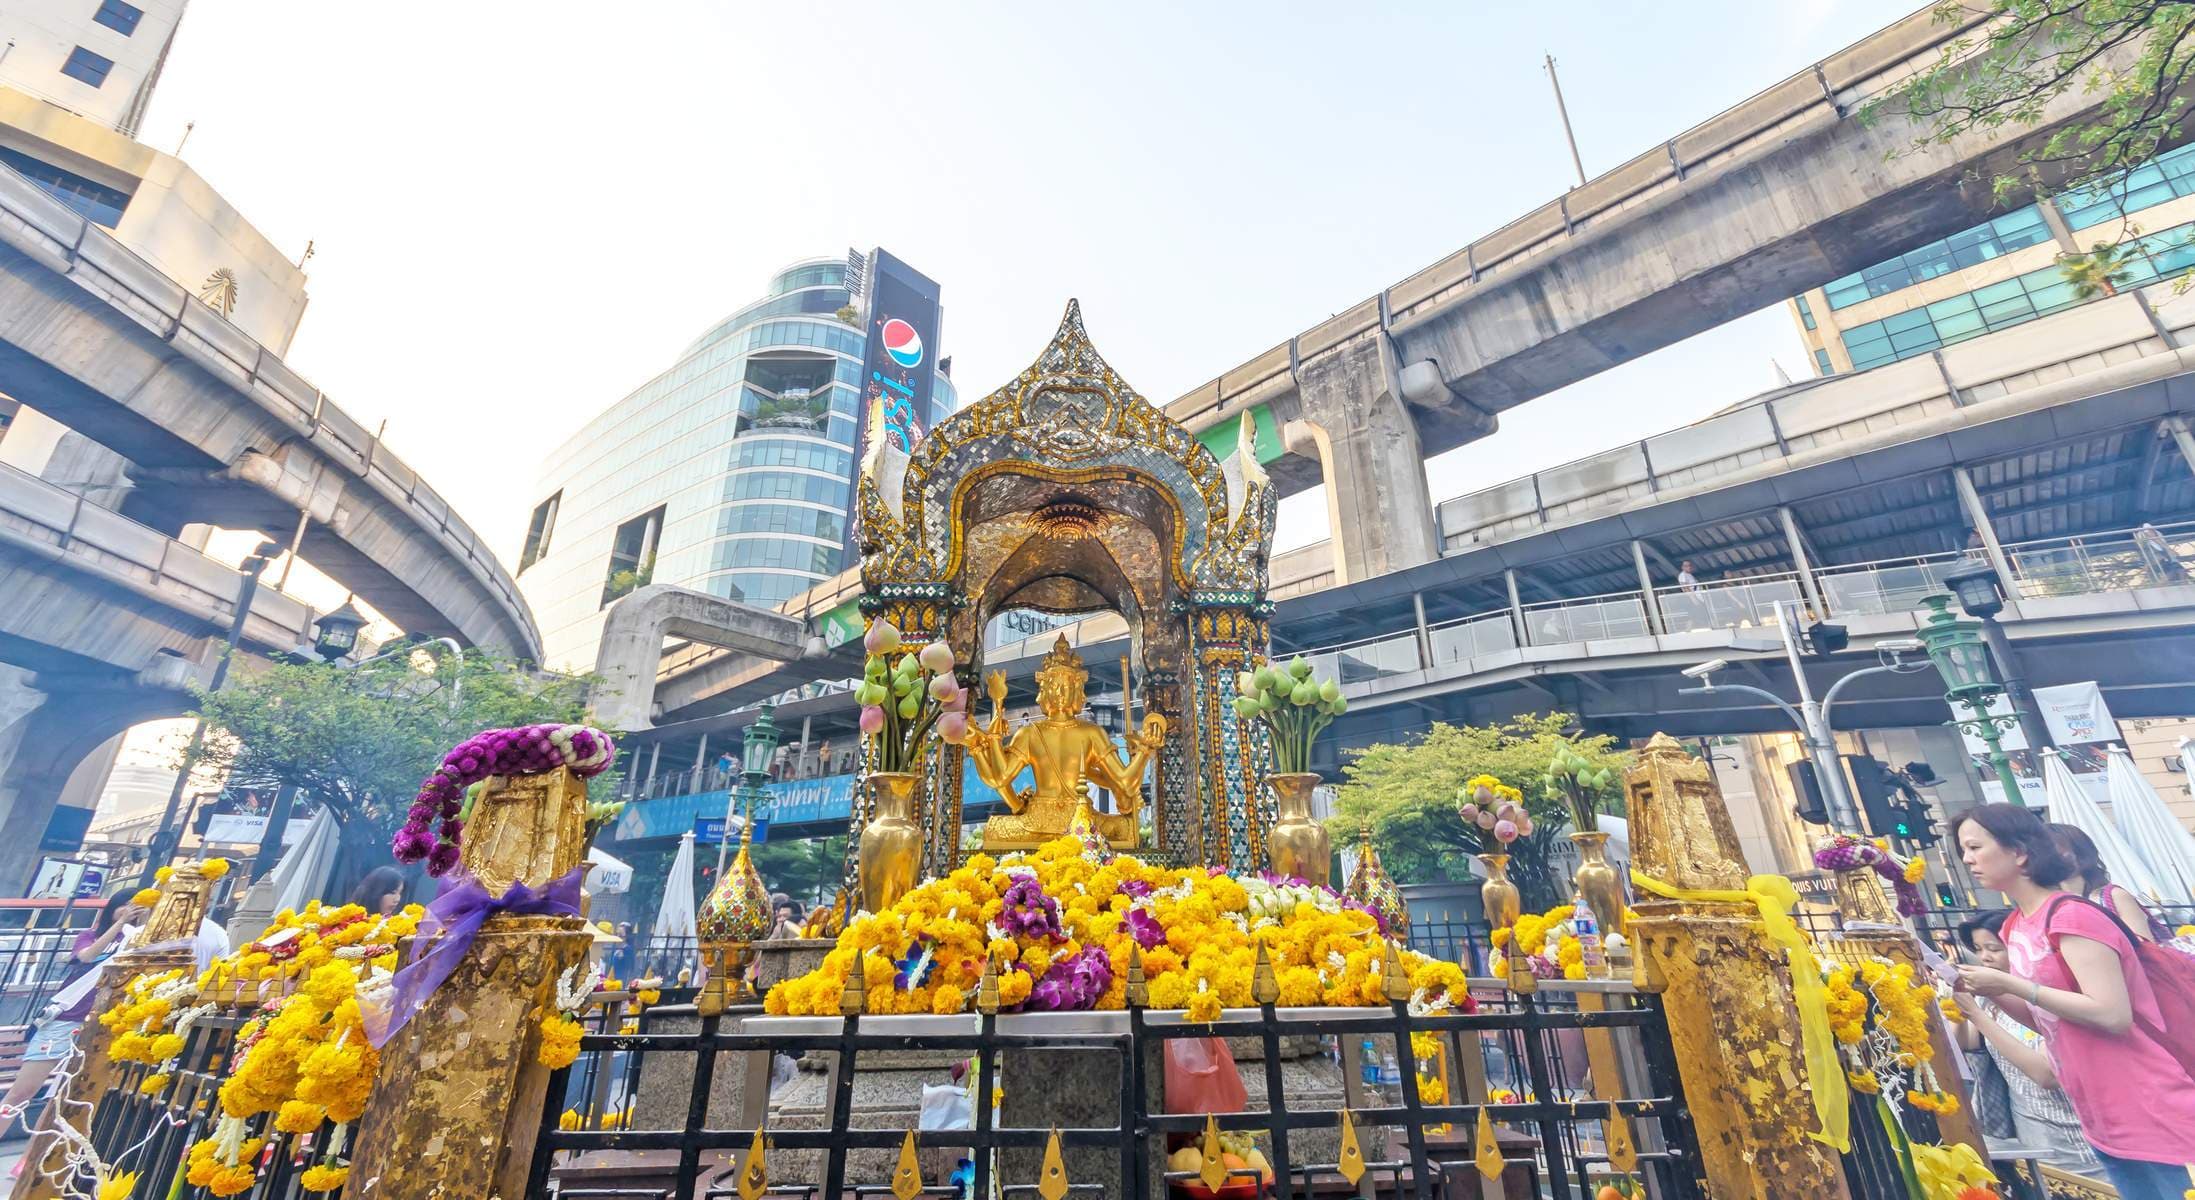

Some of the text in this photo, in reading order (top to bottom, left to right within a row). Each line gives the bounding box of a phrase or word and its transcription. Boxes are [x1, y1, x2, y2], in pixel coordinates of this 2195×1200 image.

[2020, 782, 2040, 790] VISA
[601, 871, 621, 887] VISA
[1791, 878, 1839, 893] OUIS VUIT
